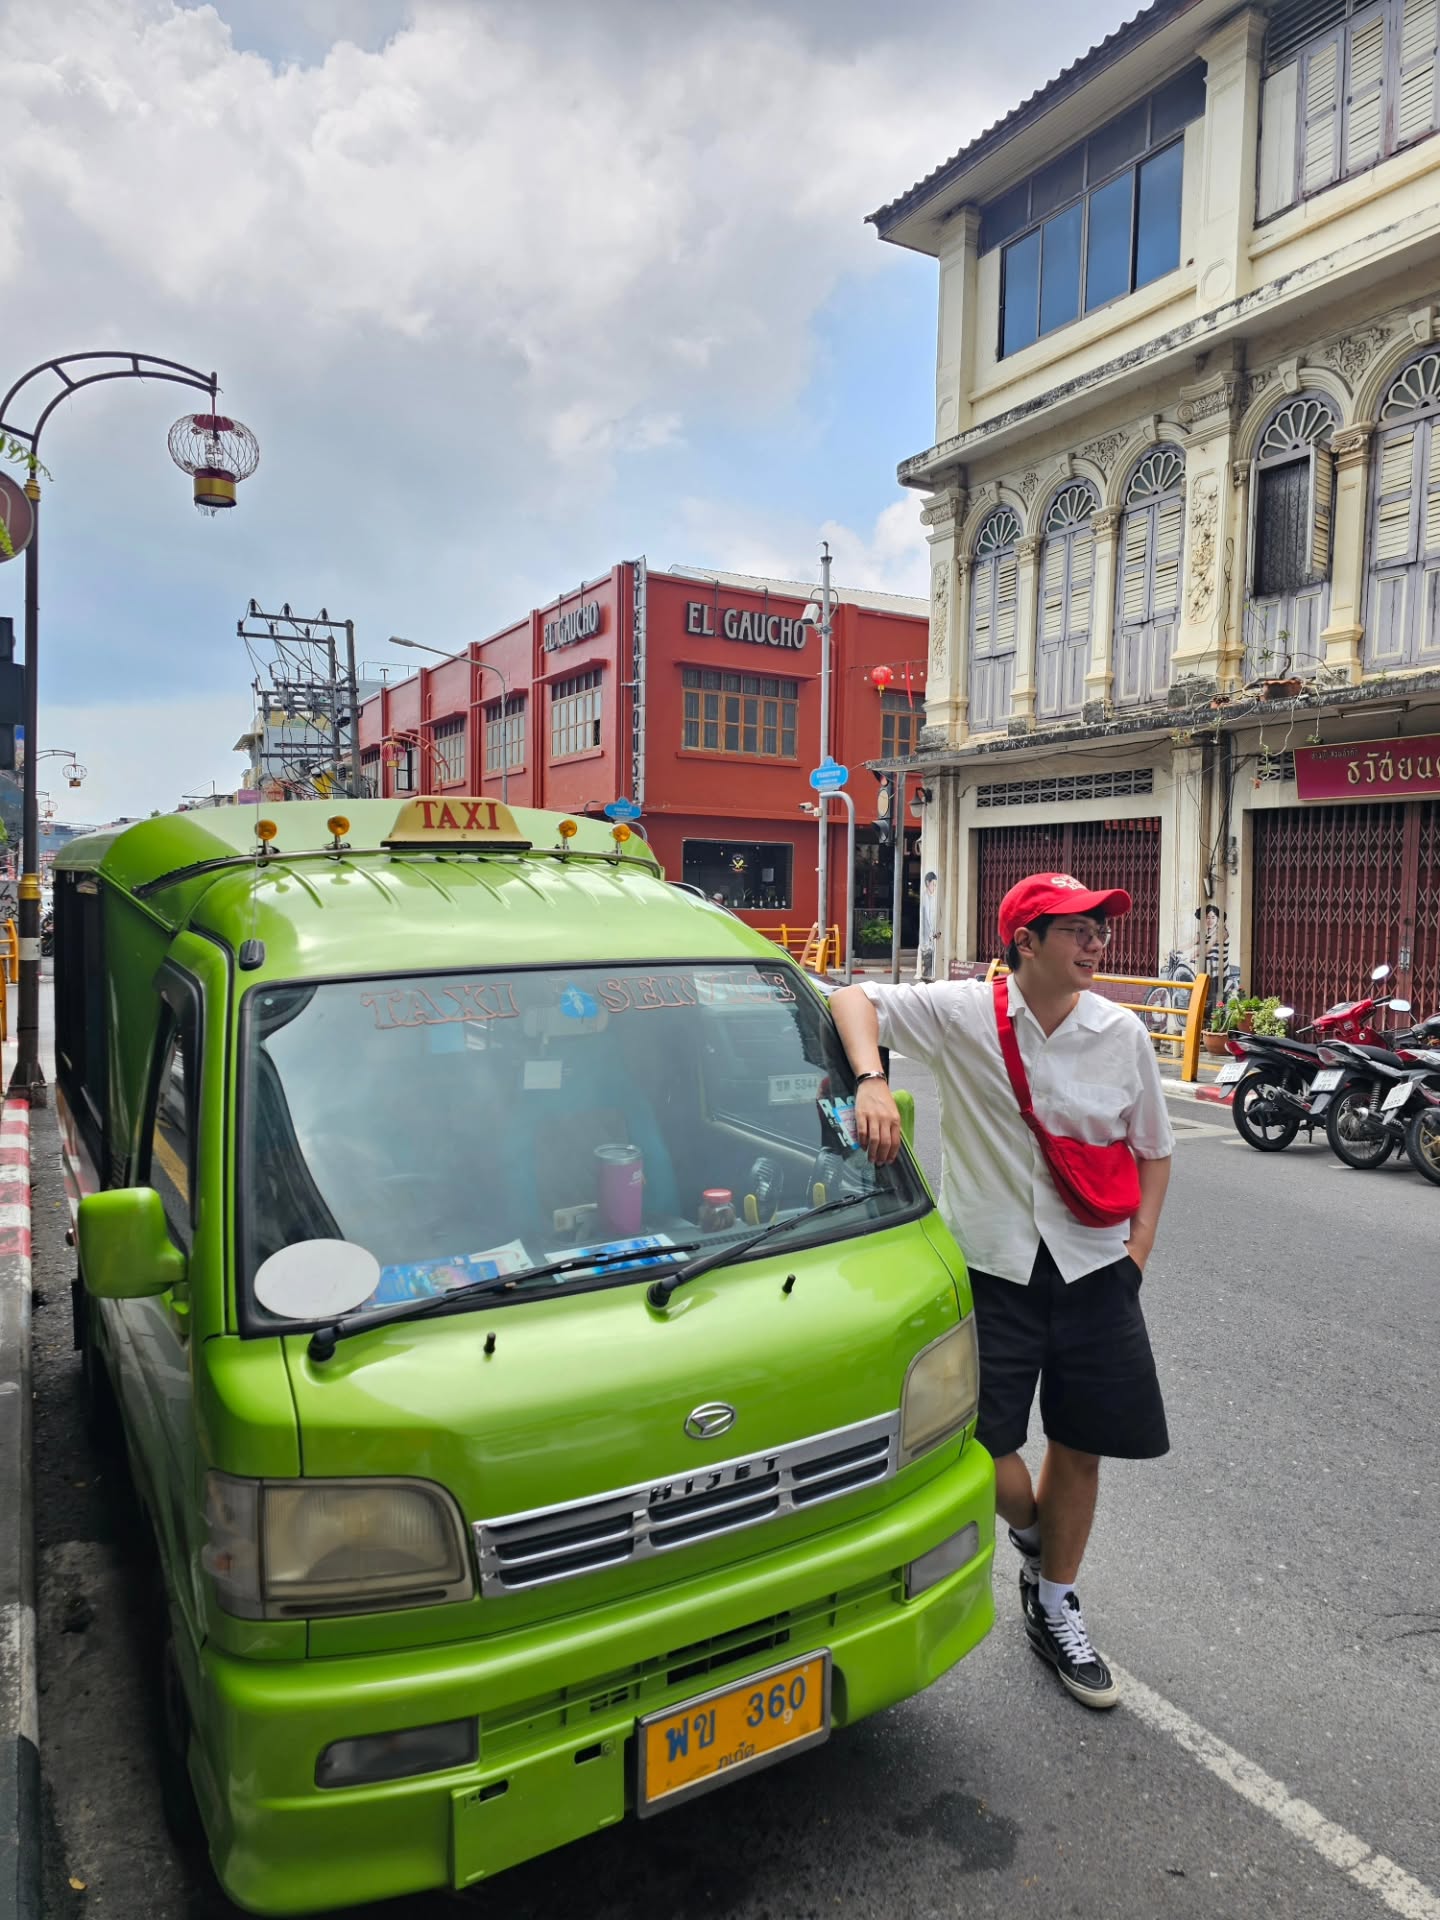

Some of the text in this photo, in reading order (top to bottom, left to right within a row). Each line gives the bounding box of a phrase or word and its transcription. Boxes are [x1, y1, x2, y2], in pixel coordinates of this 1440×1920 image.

[544, 600, 600, 653] EL GAUCHO
[687, 602, 807, 649] EL GAUCHO
[415, 800, 500, 830] TAXI
[360, 982, 521, 1030] TAXI
[596, 971, 797, 1013] SERVICE
[649, 1453, 780, 1504] HIJET
[747, 1675, 806, 1728] 360
